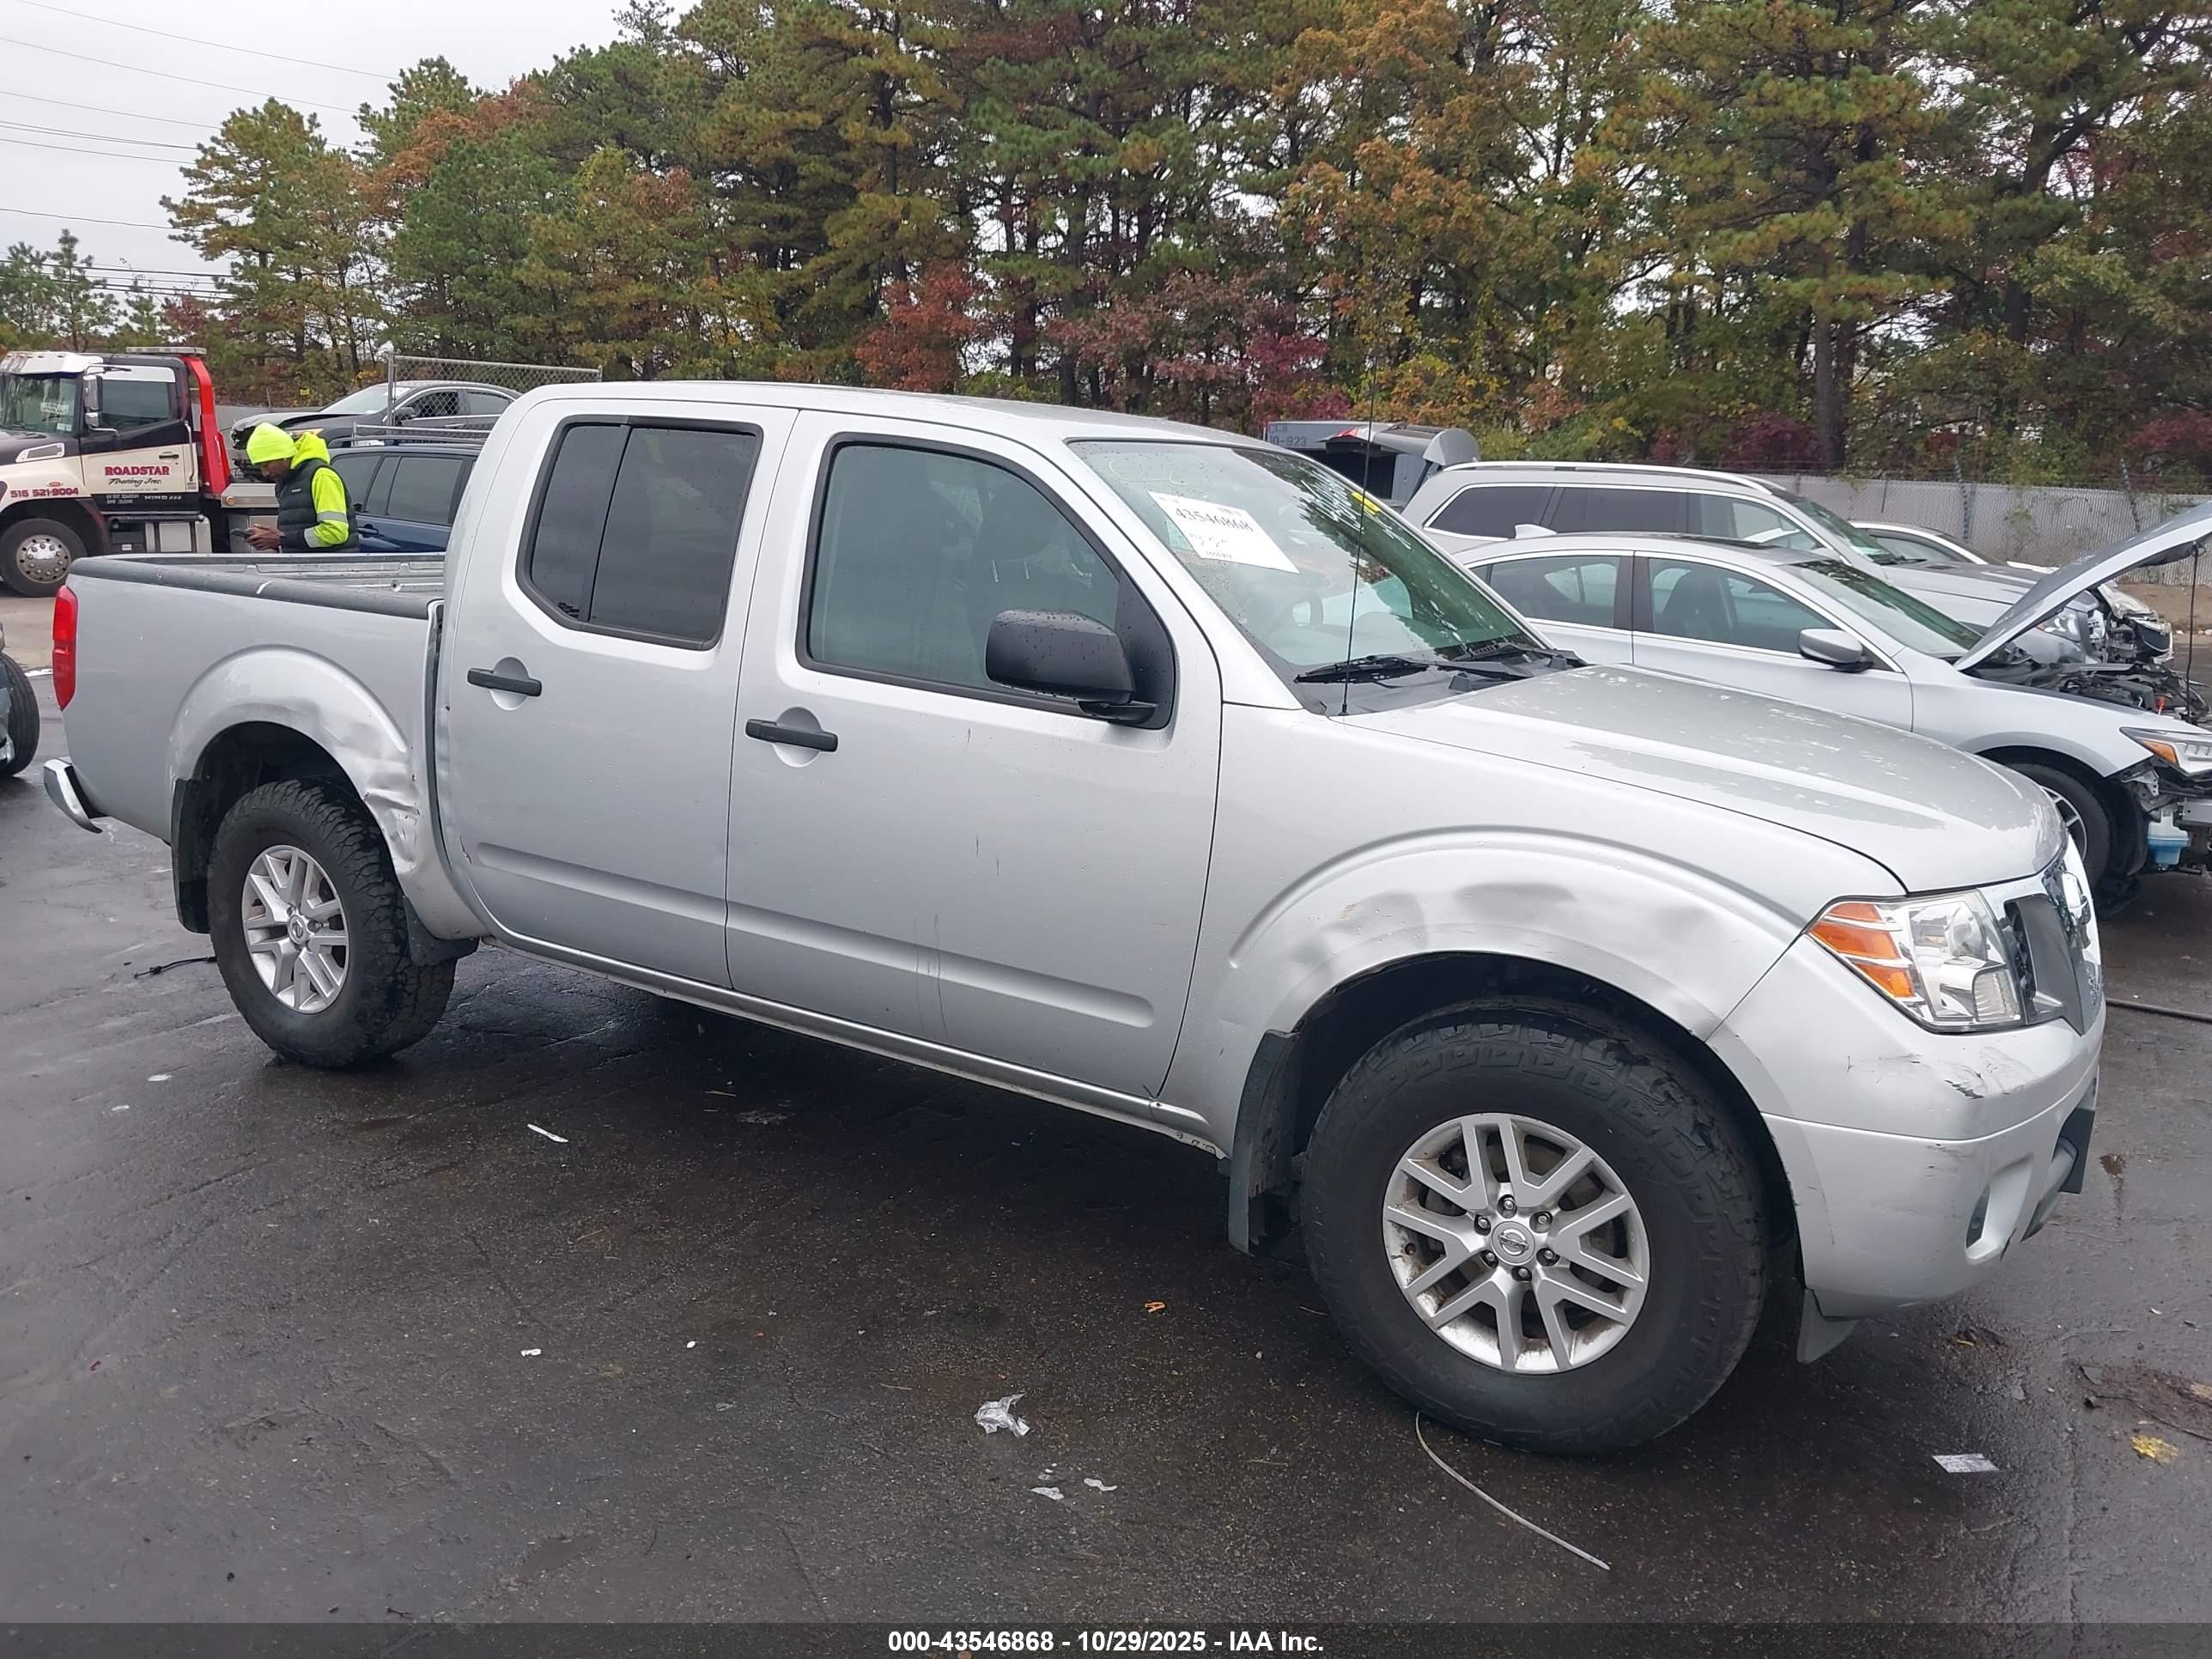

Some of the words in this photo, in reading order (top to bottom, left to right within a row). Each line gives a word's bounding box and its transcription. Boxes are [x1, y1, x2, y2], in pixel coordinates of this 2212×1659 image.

[105, 466, 170, 476] ROADSTAR
[109, 477, 143, 487] Towing
[10, 489, 29, 498] 516
[32, 487, 79, 497] 521-9004
[1176, 507, 1254, 532] 43546868
